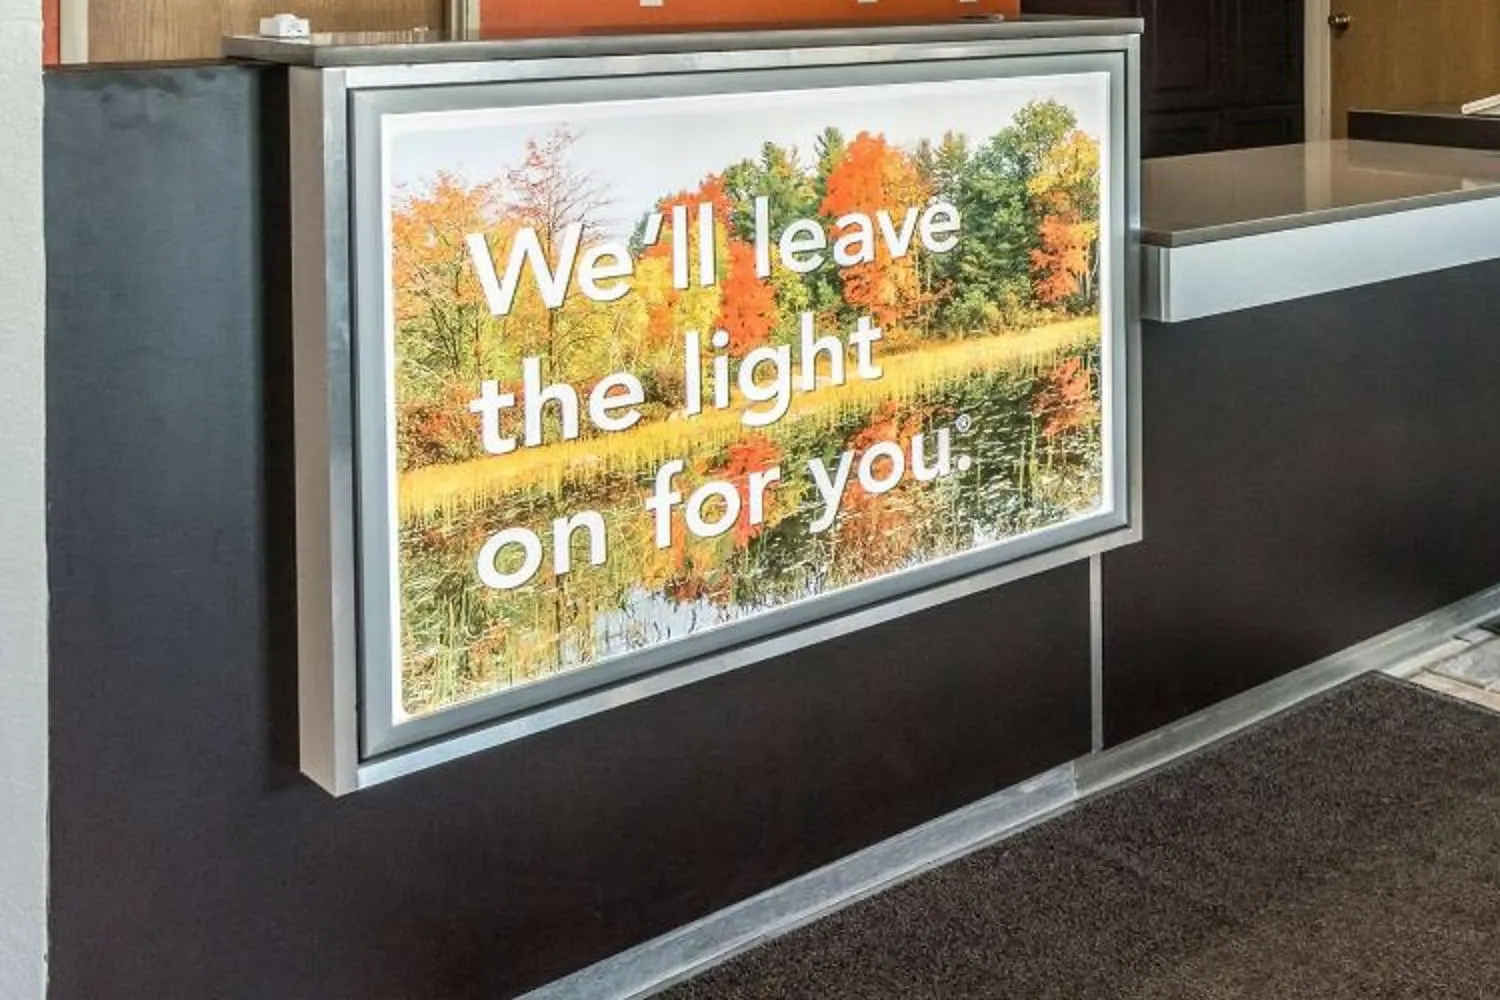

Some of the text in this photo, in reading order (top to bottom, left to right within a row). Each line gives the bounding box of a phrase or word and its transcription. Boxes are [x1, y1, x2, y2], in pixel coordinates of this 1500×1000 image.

[467, 195, 961, 316] We'll leave
[470, 312, 883, 456] the light
[477, 505, 607, 590] on
[648, 460, 783, 549] for
